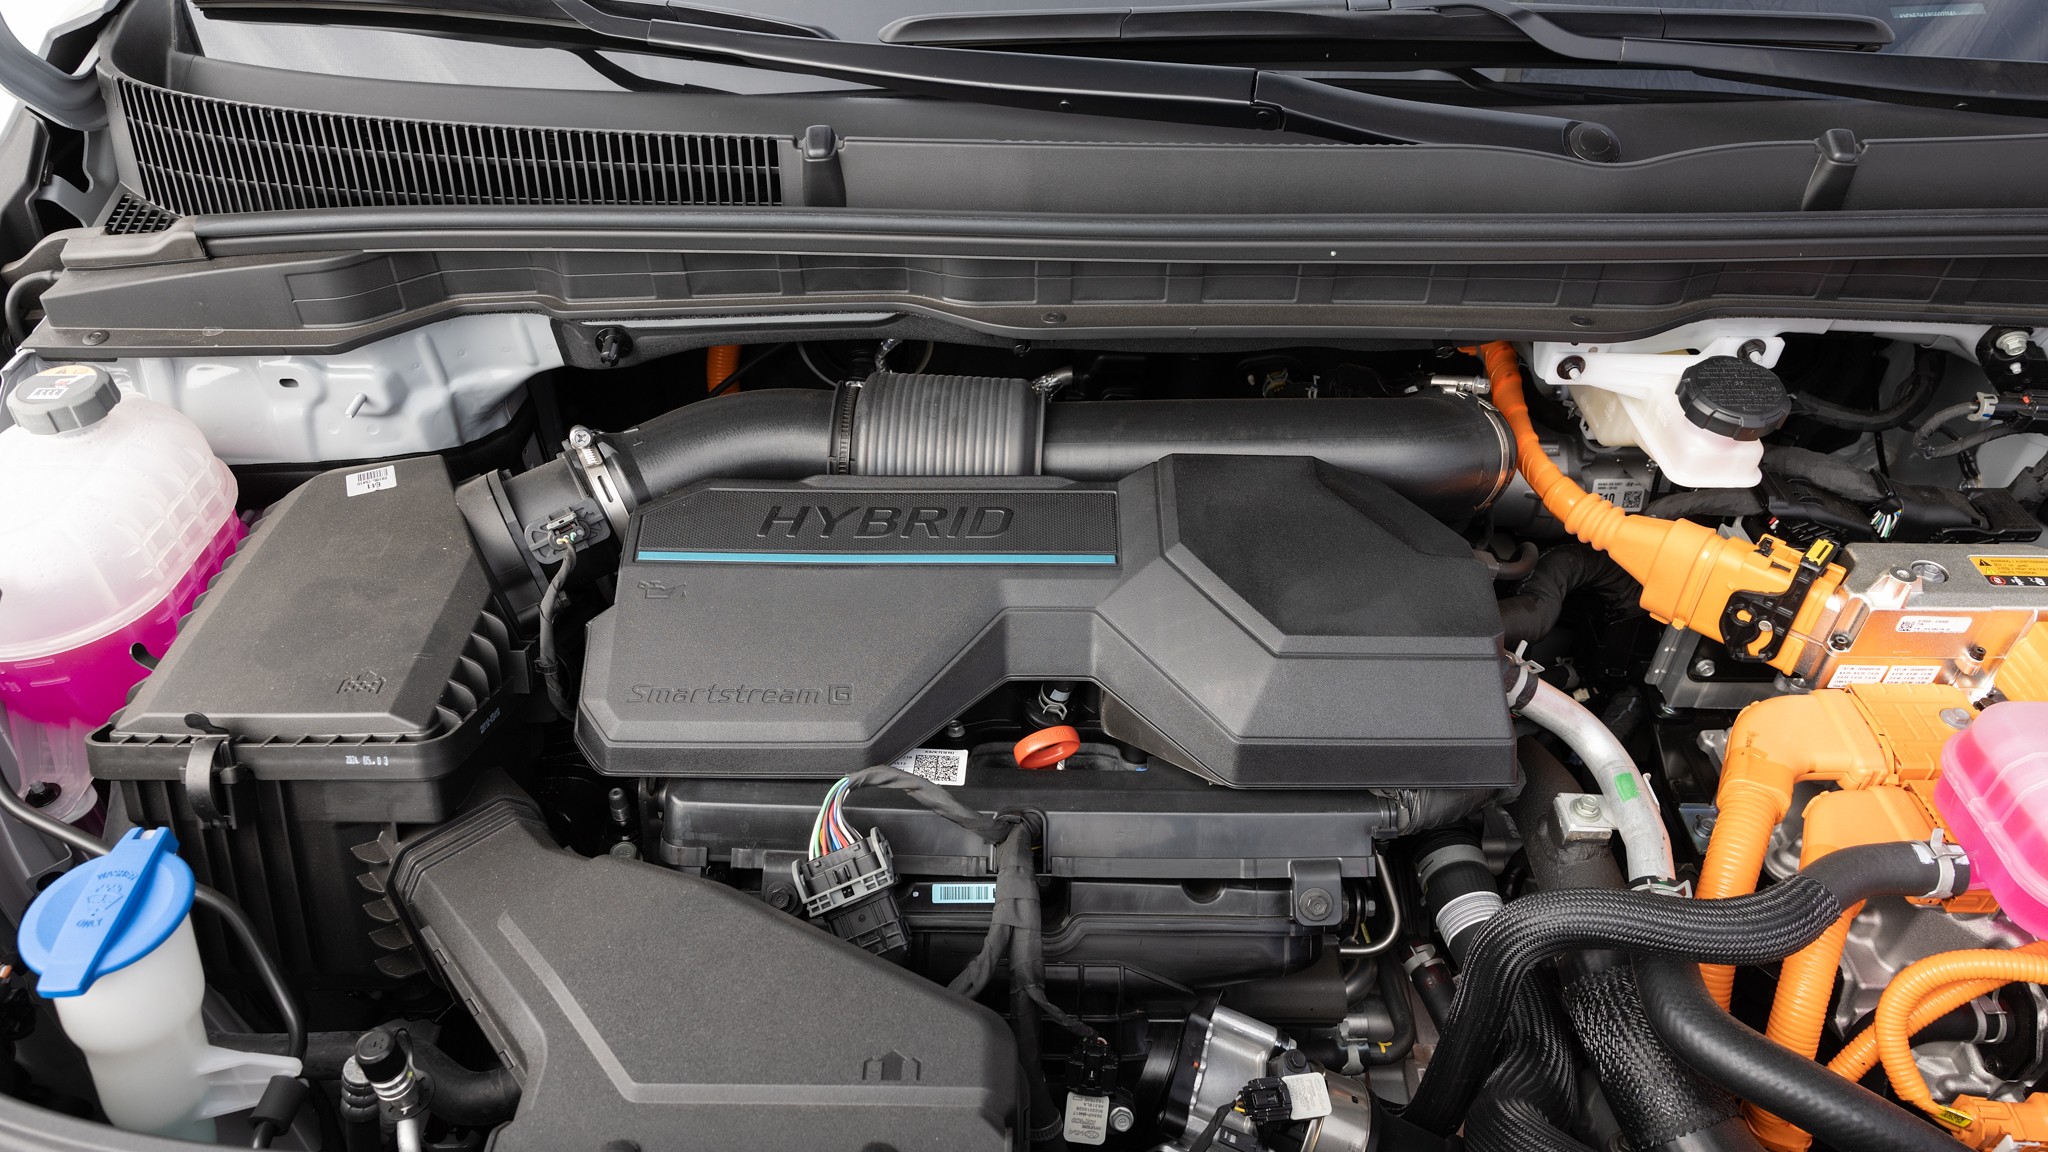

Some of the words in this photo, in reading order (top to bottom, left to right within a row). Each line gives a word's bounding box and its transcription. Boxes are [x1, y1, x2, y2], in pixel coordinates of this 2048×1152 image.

[757, 505, 1015, 539] HYBRID
[627, 684, 822, 705] Smartstream
[827, 684, 854, 705] G
